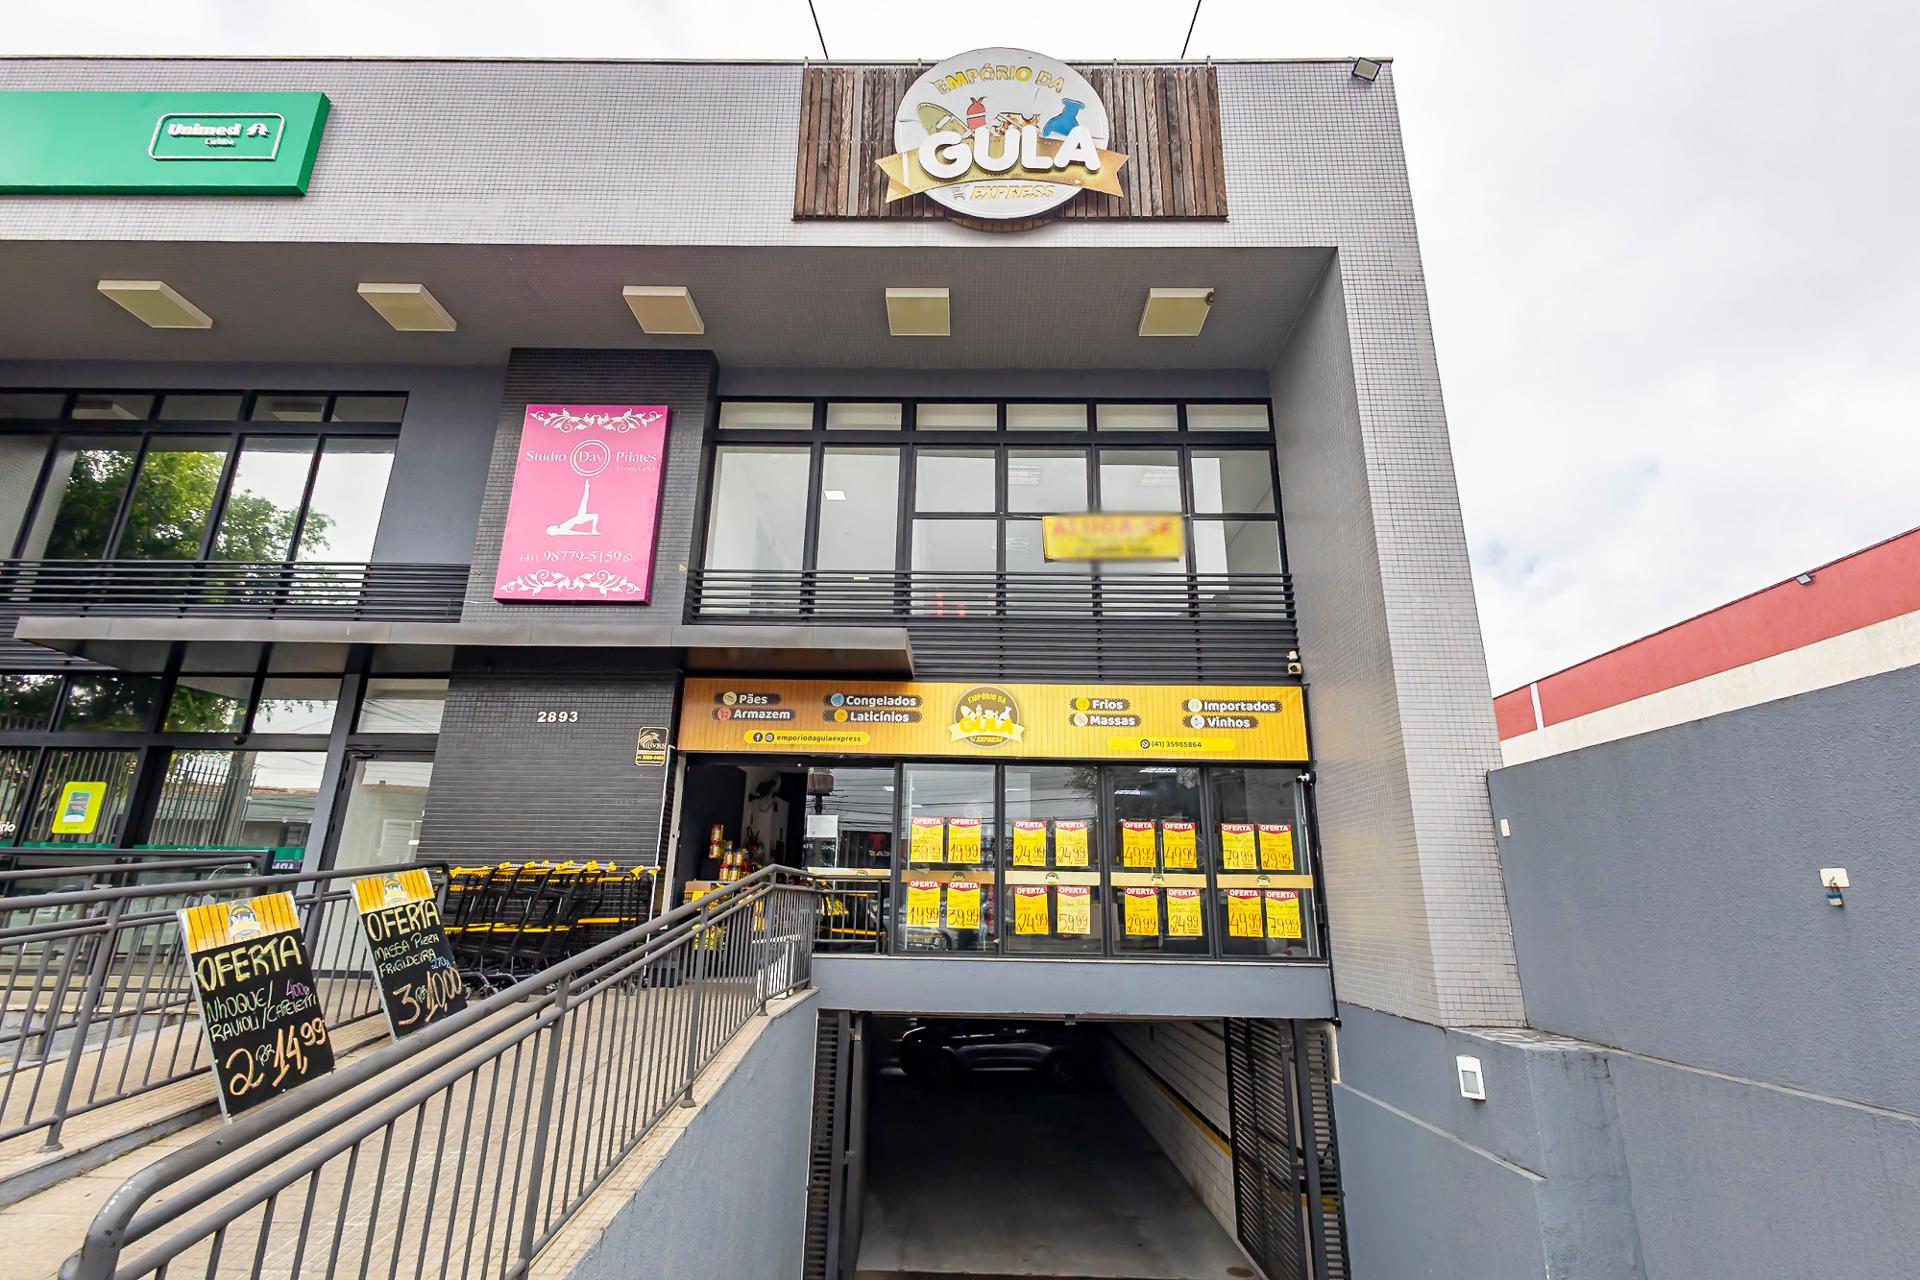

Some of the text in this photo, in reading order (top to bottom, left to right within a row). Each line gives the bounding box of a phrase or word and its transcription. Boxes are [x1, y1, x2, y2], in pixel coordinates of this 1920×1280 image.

[931, 63, 1065, 95] EMPÓRIO DA
[167, 122, 242, 136] Unimed
[918, 124, 1101, 180] GULA
[970, 184, 1055, 200] EXPRESS
[526, 450, 657, 465] Studio Day Pilates
[543, 549, 622, 563] 98779-5159
[738, 693, 768, 704] Pães
[846, 695, 917, 707] Congelados
[968, 692, 997, 704] EMPÓRIO
[1092, 699, 1123, 710] Frios
[1203, 700, 1276, 712] Importados
[537, 711, 579, 723] 2893
[733, 709, 791, 720] Armazem
[850, 710, 910, 722] Laticínios
[1089, 715, 1136, 726] Massas
[959, 716, 1013, 734] GULA
[1207, 716, 1251, 728] Vinhos
[776, 733, 862, 743] emporiodagulaexpress
[1151, 740, 1165, 748] (41)
[913, 817, 942, 825] OFERTA
[1229, 889, 1259, 897] OFERTA
[1266, 891, 1297, 899] OFERTA
[367, 901, 441, 942] OFERTA
[374, 940, 411, 962] MASSA
[196, 935, 303, 992] OFERTA
[393, 982, 421, 1026] 3
[225, 1047, 266, 1096] 2
[272, 1017, 328, 1088] 14,99
